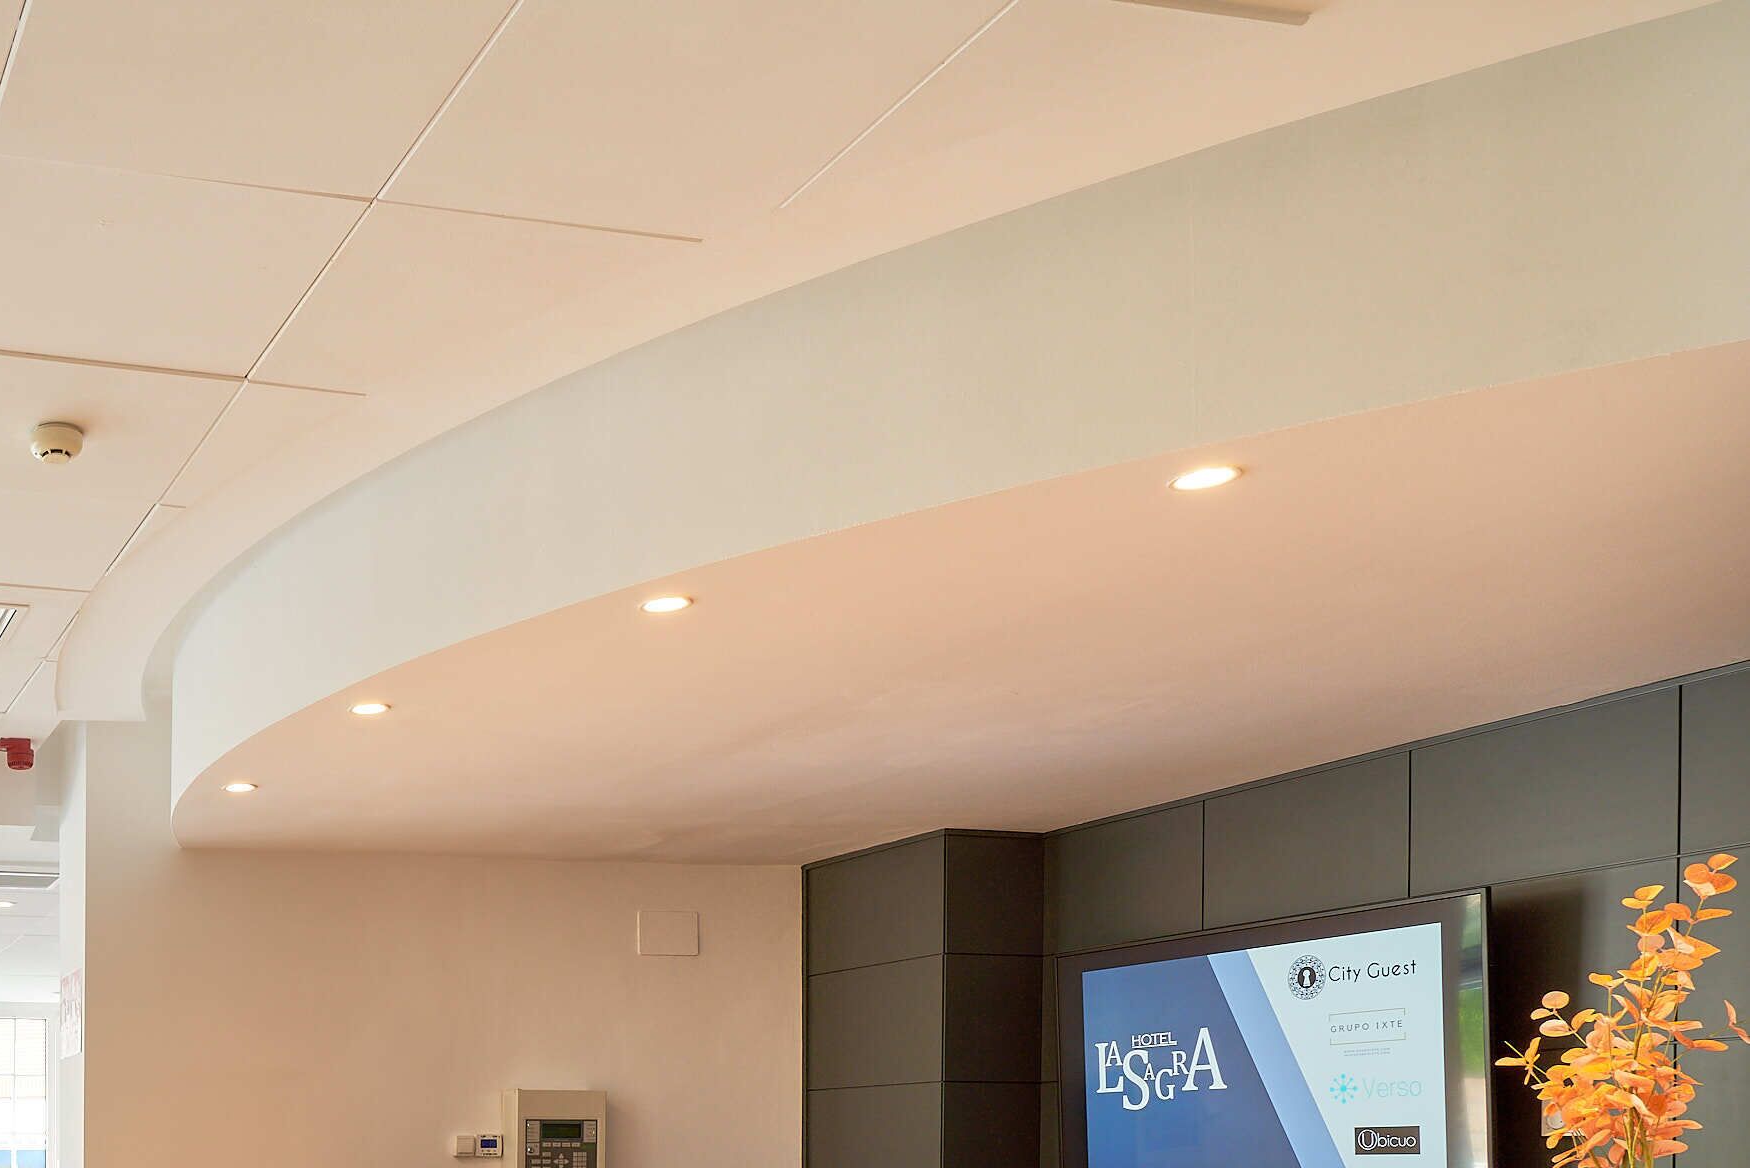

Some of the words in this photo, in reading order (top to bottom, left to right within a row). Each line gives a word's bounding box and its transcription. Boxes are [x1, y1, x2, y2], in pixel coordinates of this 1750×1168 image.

[1328, 966, 1361, 982] City
[1367, 960, 1416, 978] Guest
[1330, 1022, 1370, 1033] GRUPO
[1375, 1019, 1403, 1030] IXTE
[1131, 1031, 1178, 1048] HOTEL
[1095, 1040, 1123, 1093] LA
[1122, 1027, 1227, 1111] SAGRA
[1361, 1077, 1422, 1098] Verso
[1358, 1129, 1417, 1150] Ubicuo
